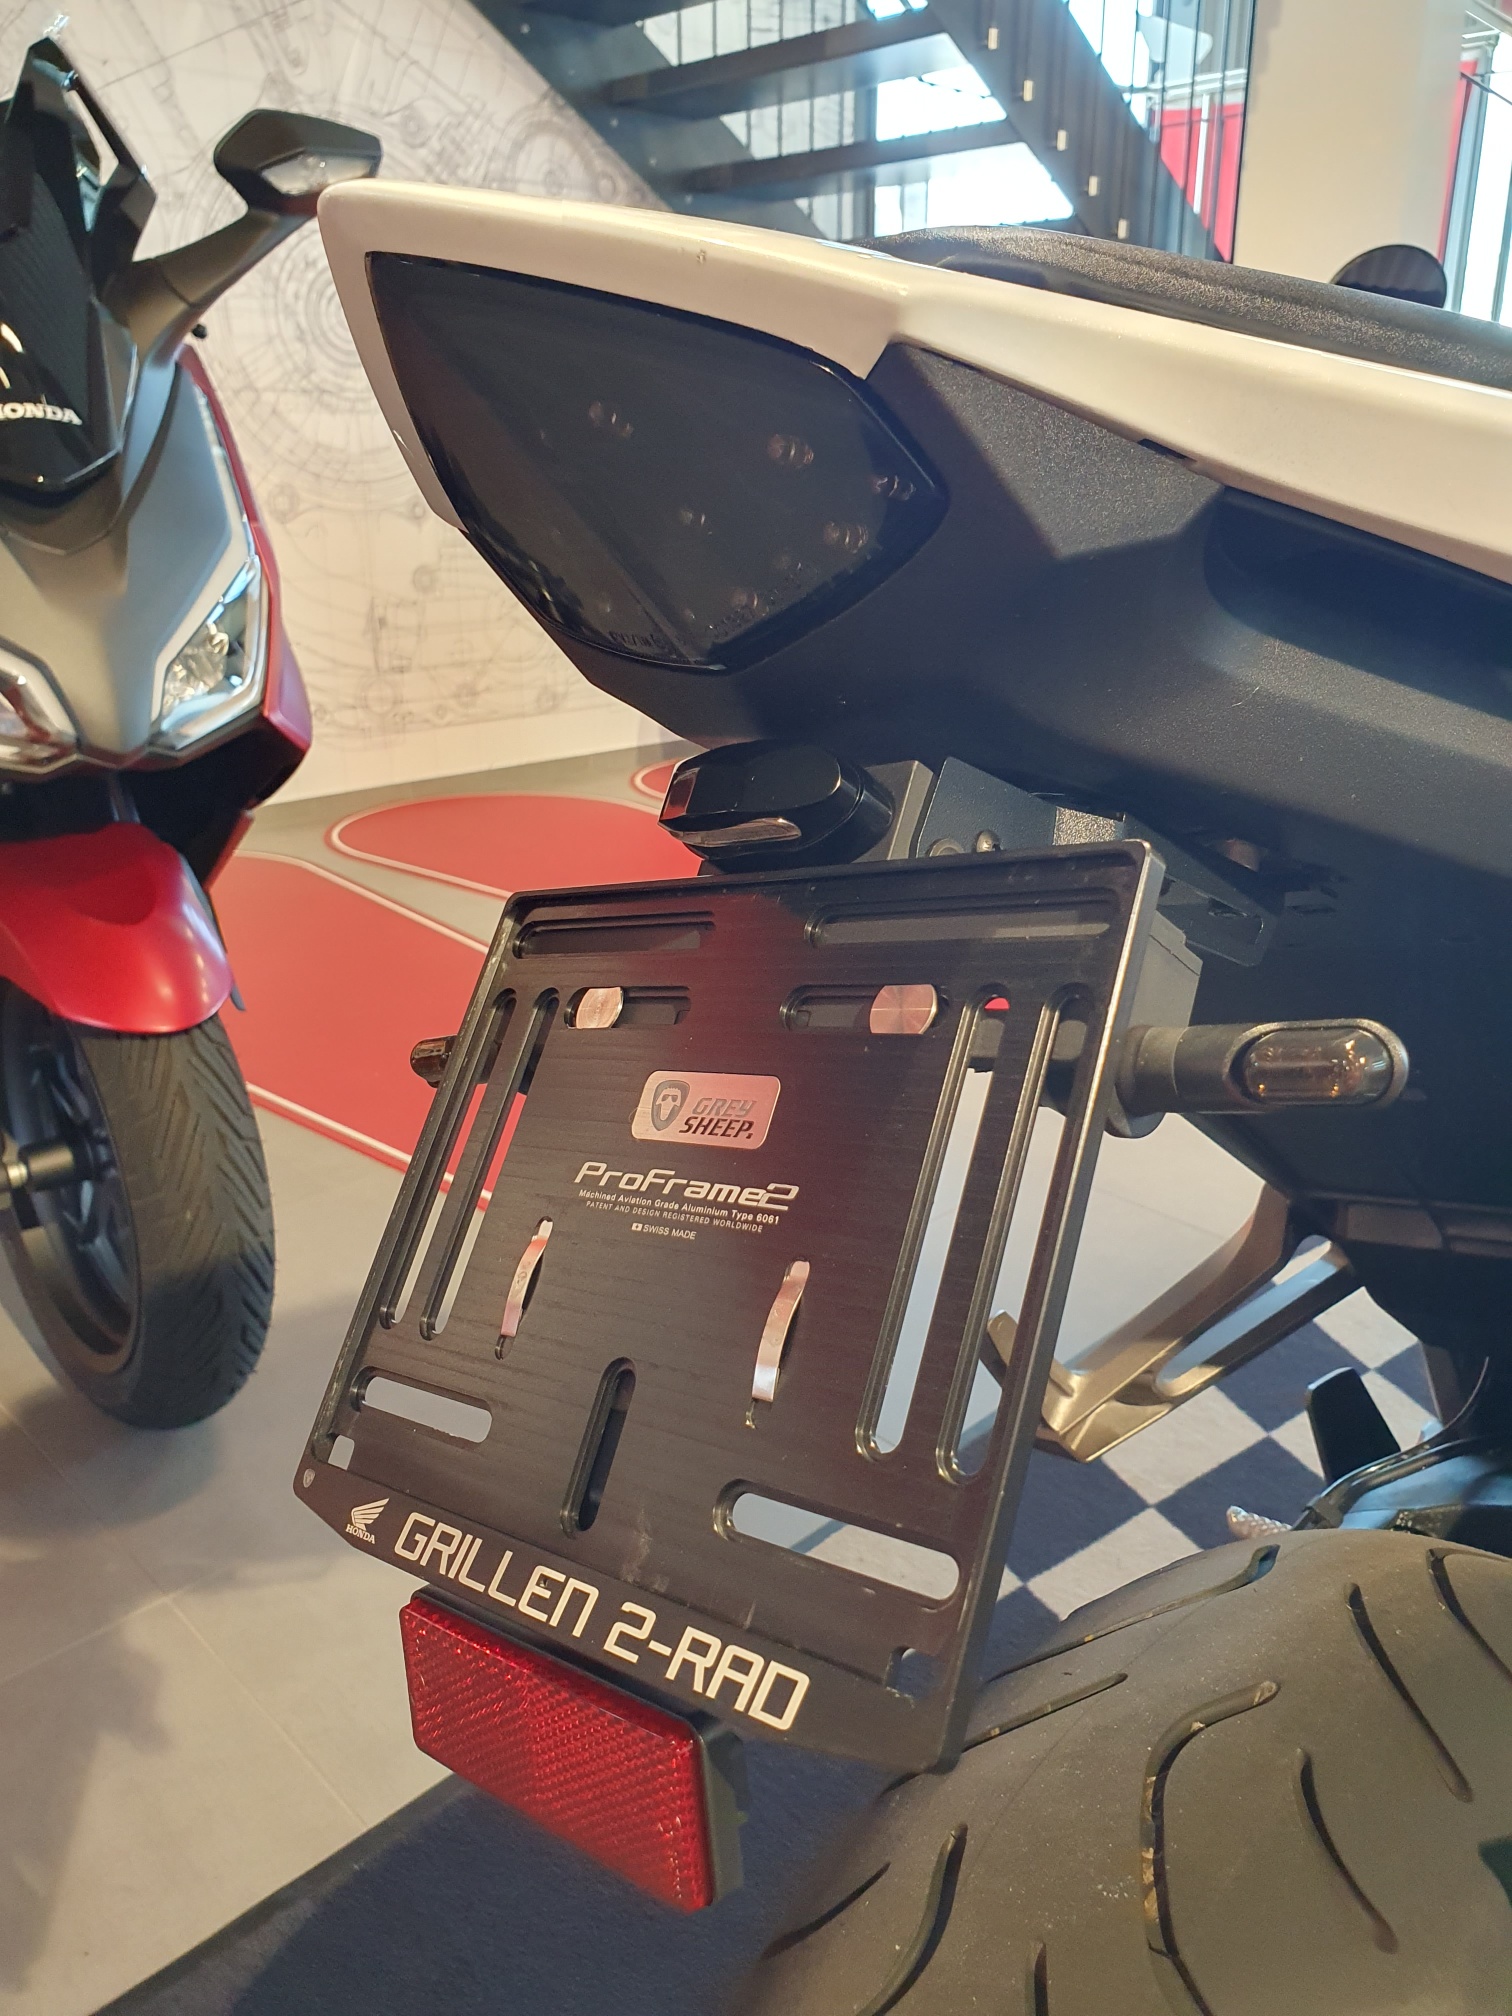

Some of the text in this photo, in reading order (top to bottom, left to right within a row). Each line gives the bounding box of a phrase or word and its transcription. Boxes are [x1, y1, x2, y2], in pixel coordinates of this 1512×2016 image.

[0, 402, 83, 425] ONDA
[691, 1097, 757, 1118] GREY
[579, 1189, 780, 1225] Machined Aviation Grade Aluminium Type 6061
[586, 1200, 764, 1233] PATENT AND DESIGN REGISTERED WORLDWIDE
[643, 1224, 697, 1240] SWISS MADE
[345, 1523, 376, 1545] HONDA
[394, 1511, 811, 1731] GRILLEN 2-RAD
